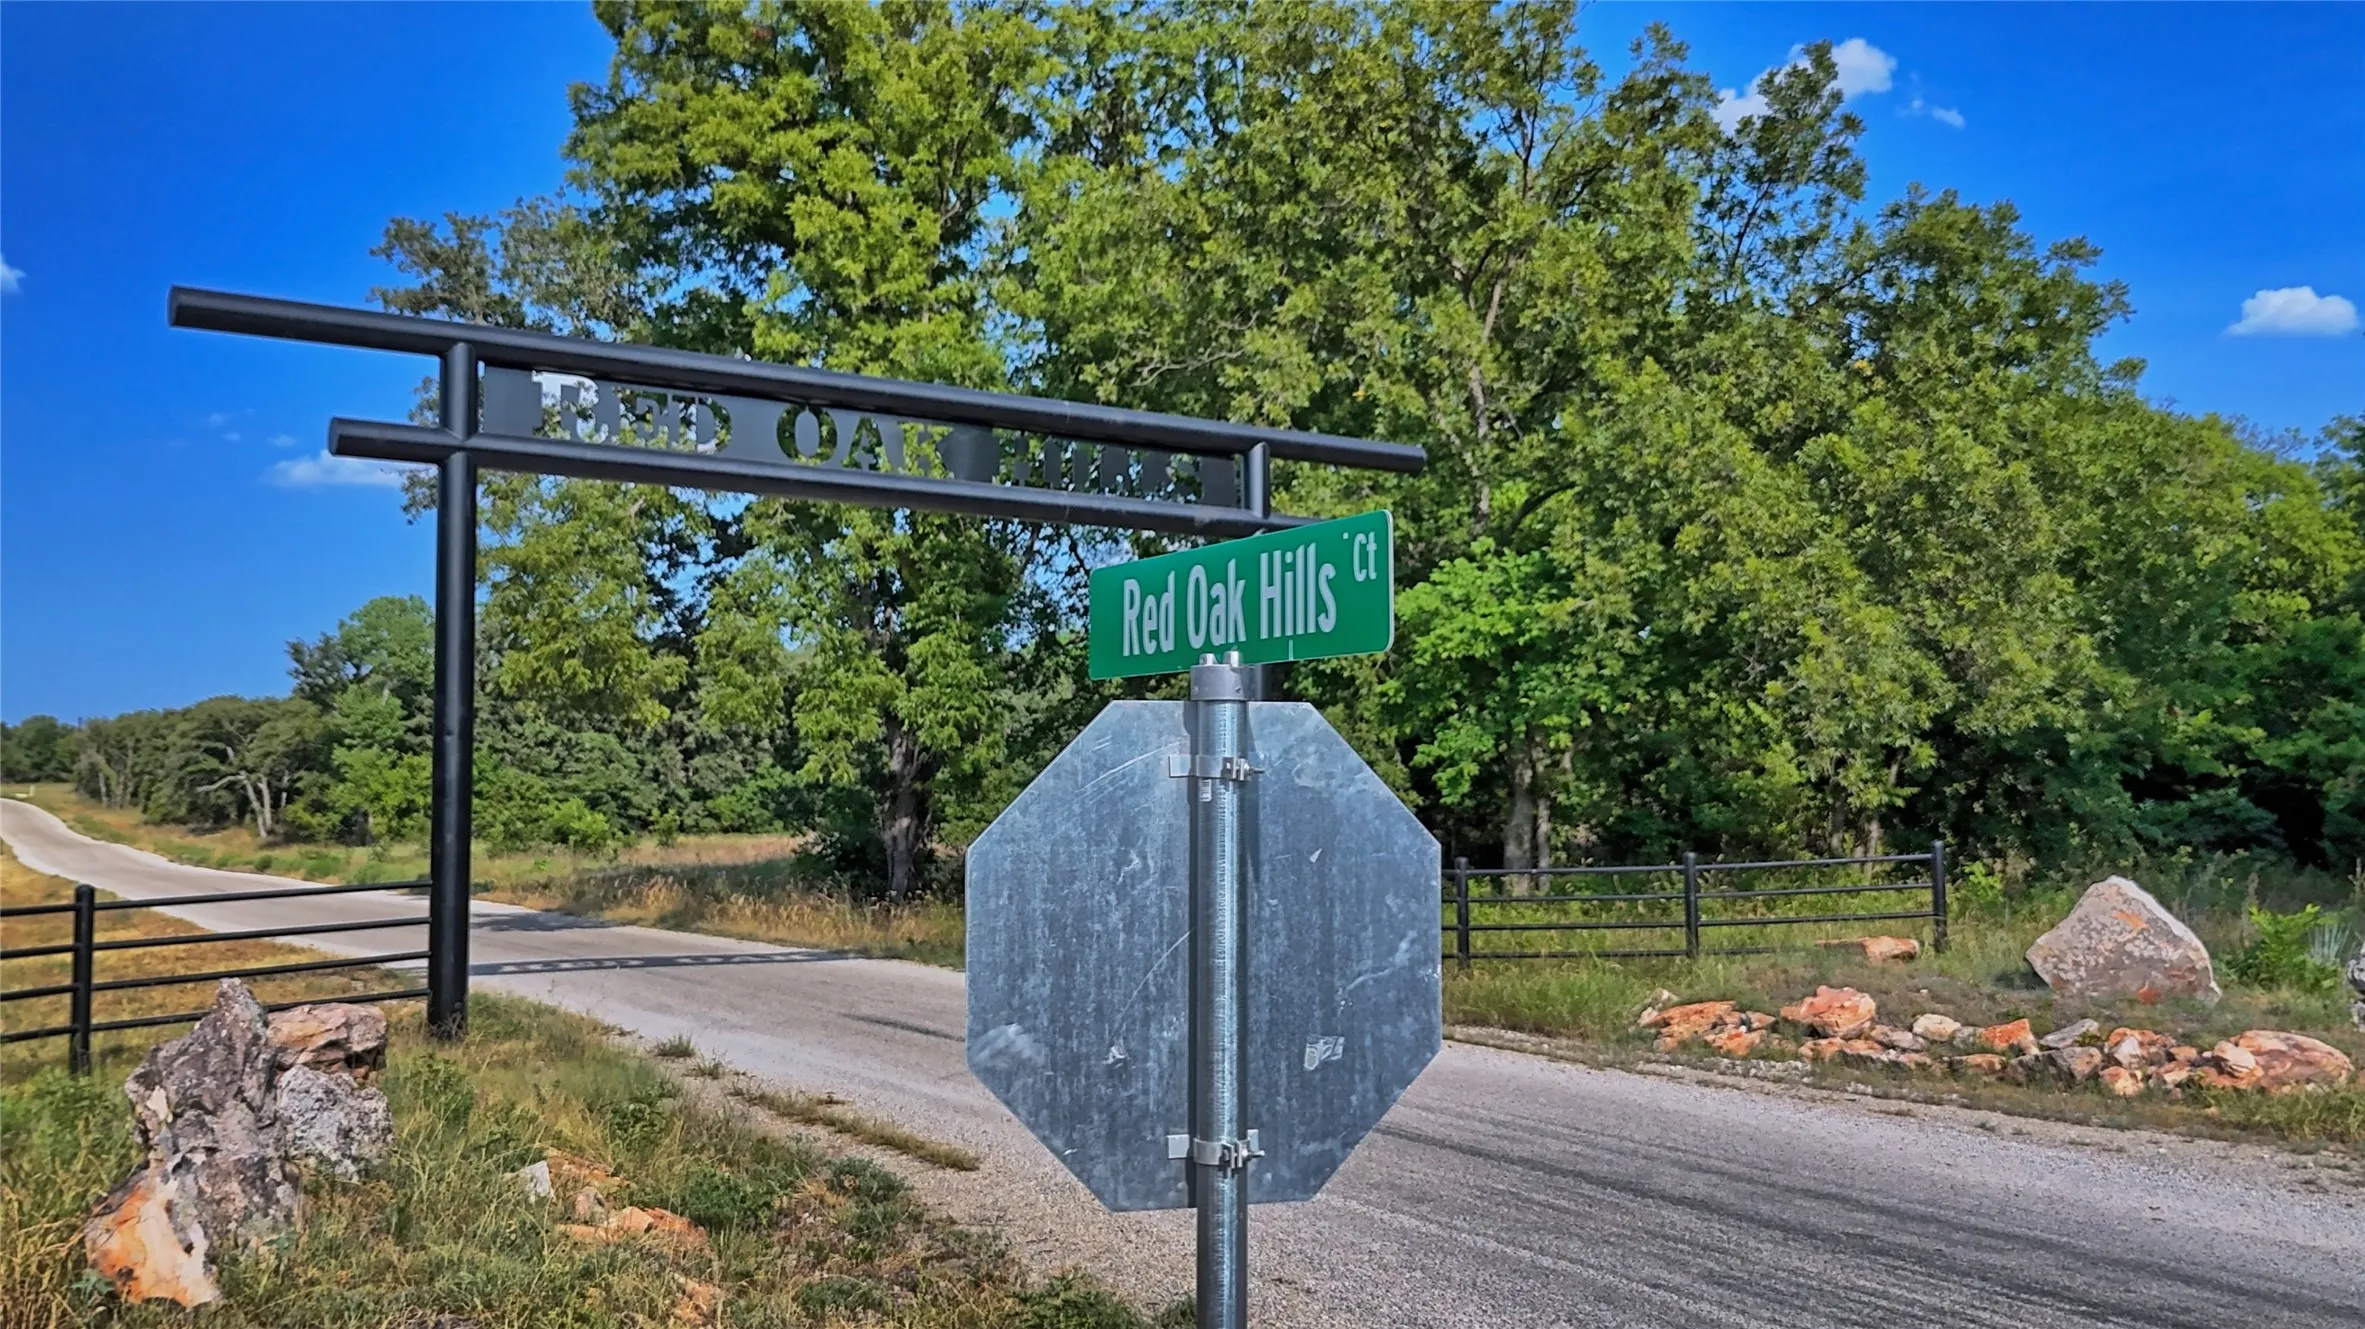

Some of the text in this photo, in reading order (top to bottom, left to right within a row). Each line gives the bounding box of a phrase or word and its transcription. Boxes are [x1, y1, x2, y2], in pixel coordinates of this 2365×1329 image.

[532, 370, 733, 455] RED
[776, 402, 955, 480] OAK
[1122, 531, 1378, 657] Red Oak Hills Ct
